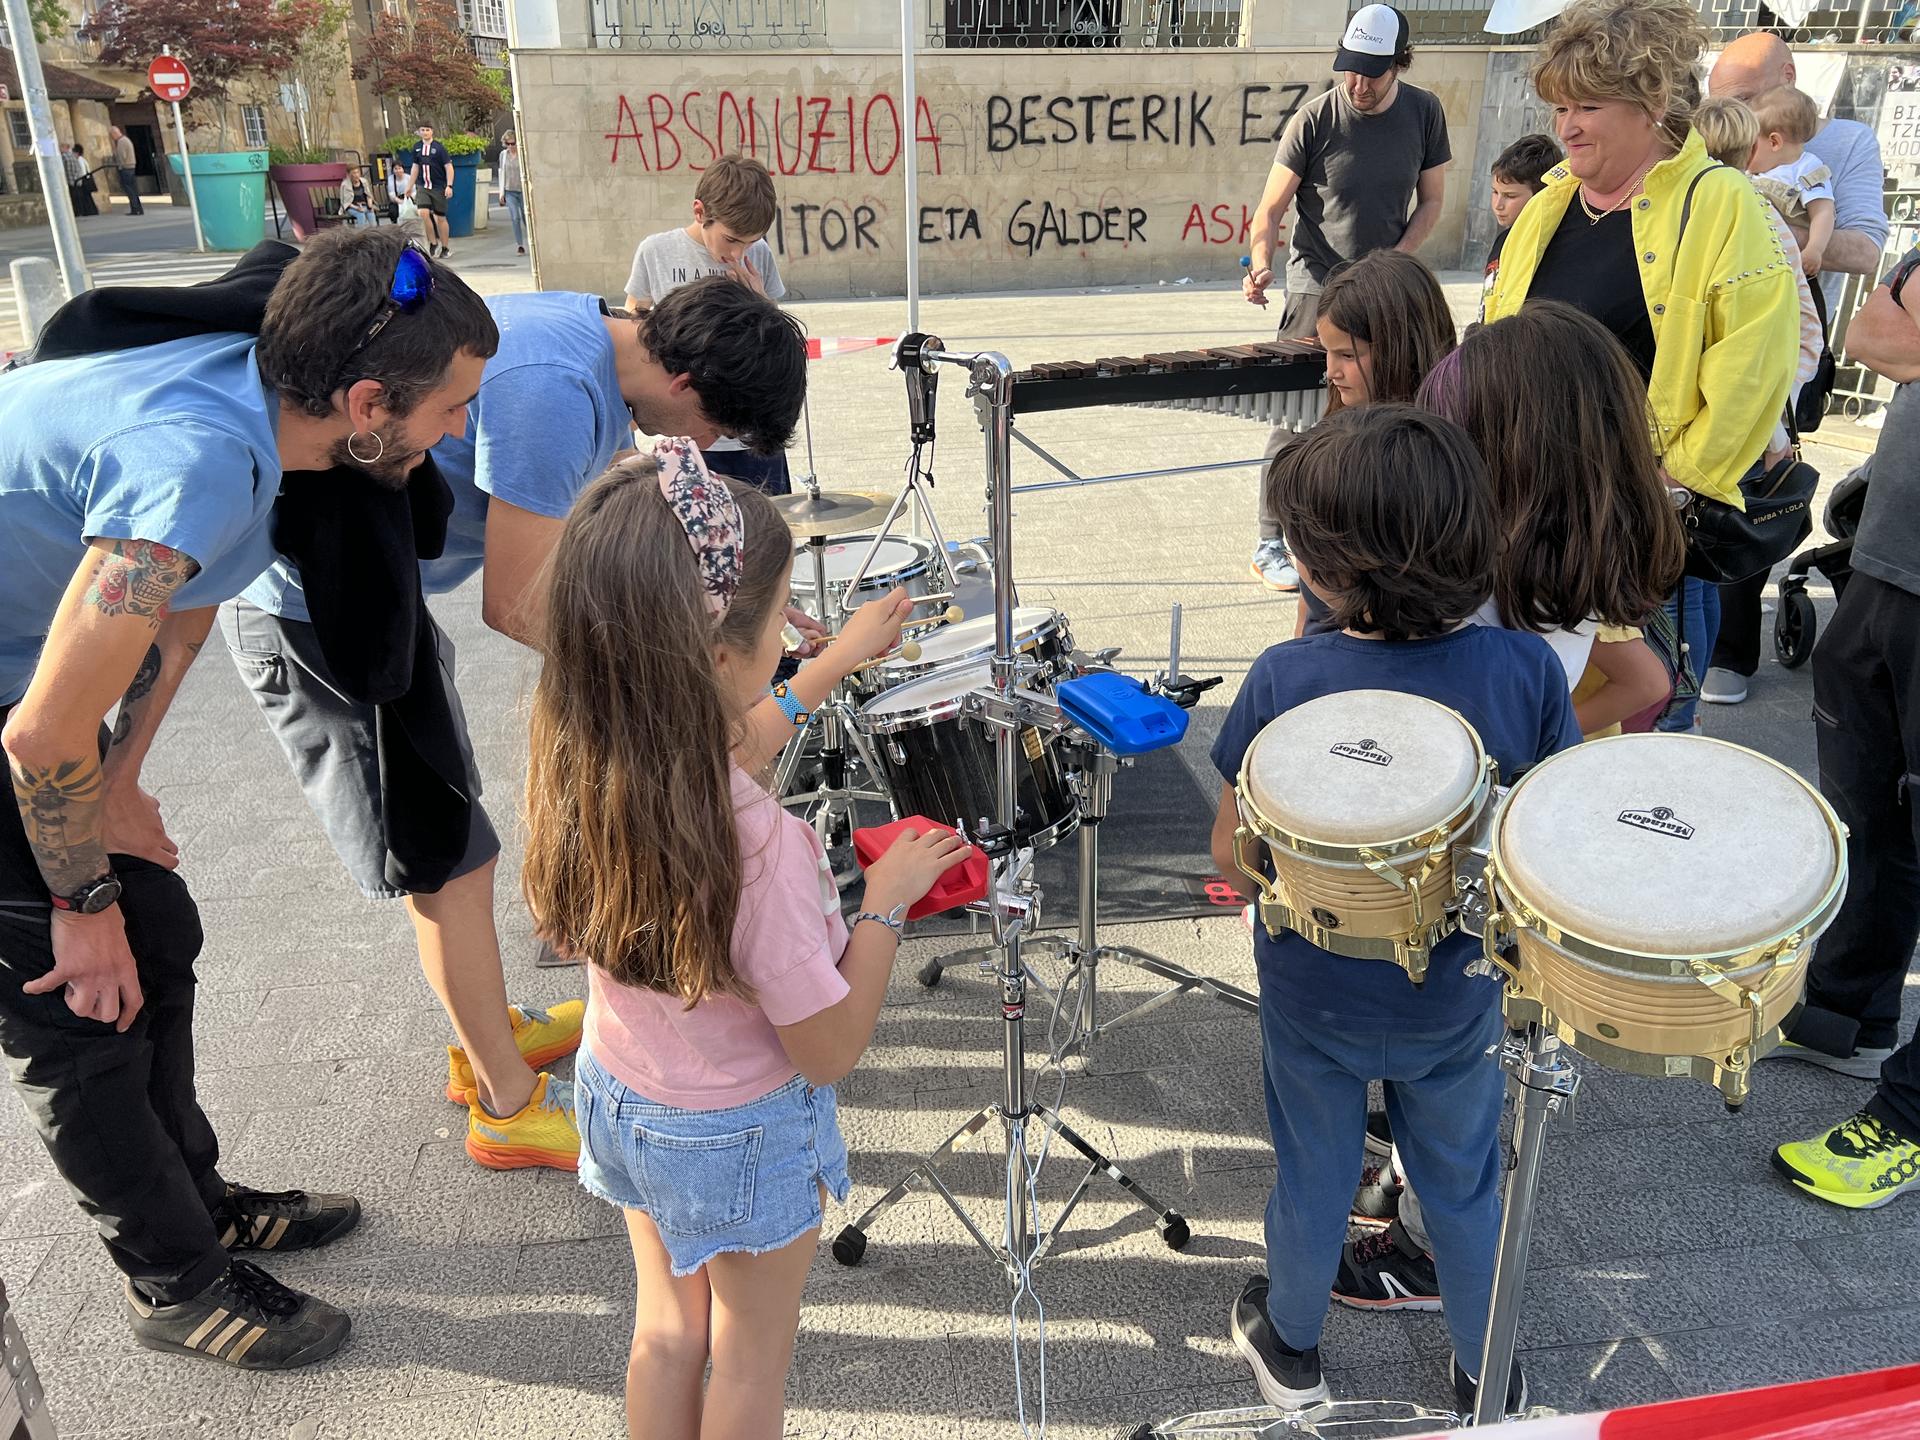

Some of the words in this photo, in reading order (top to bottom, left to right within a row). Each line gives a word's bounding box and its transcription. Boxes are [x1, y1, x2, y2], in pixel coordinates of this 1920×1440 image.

[1894, 105, 1920, 120] BI
[604, 90, 943, 176] ABSOLUZIOA
[986, 90, 1216, 152] BESTERIK
[1240, 83, 1309, 147] EZ
[764, 203, 880, 256] ITOR
[918, 206, 982, 244] ETA
[1007, 199, 1148, 257] GALDER
[672, 268, 686, 282] IN
[694, 268, 701, 280] A
[1753, 511, 1777, 525] BIMBA
[1785, 502, 1805, 513] LOLA
[1333, 745, 1390, 763] Matador
[1621, 813, 1691, 836] Matador
